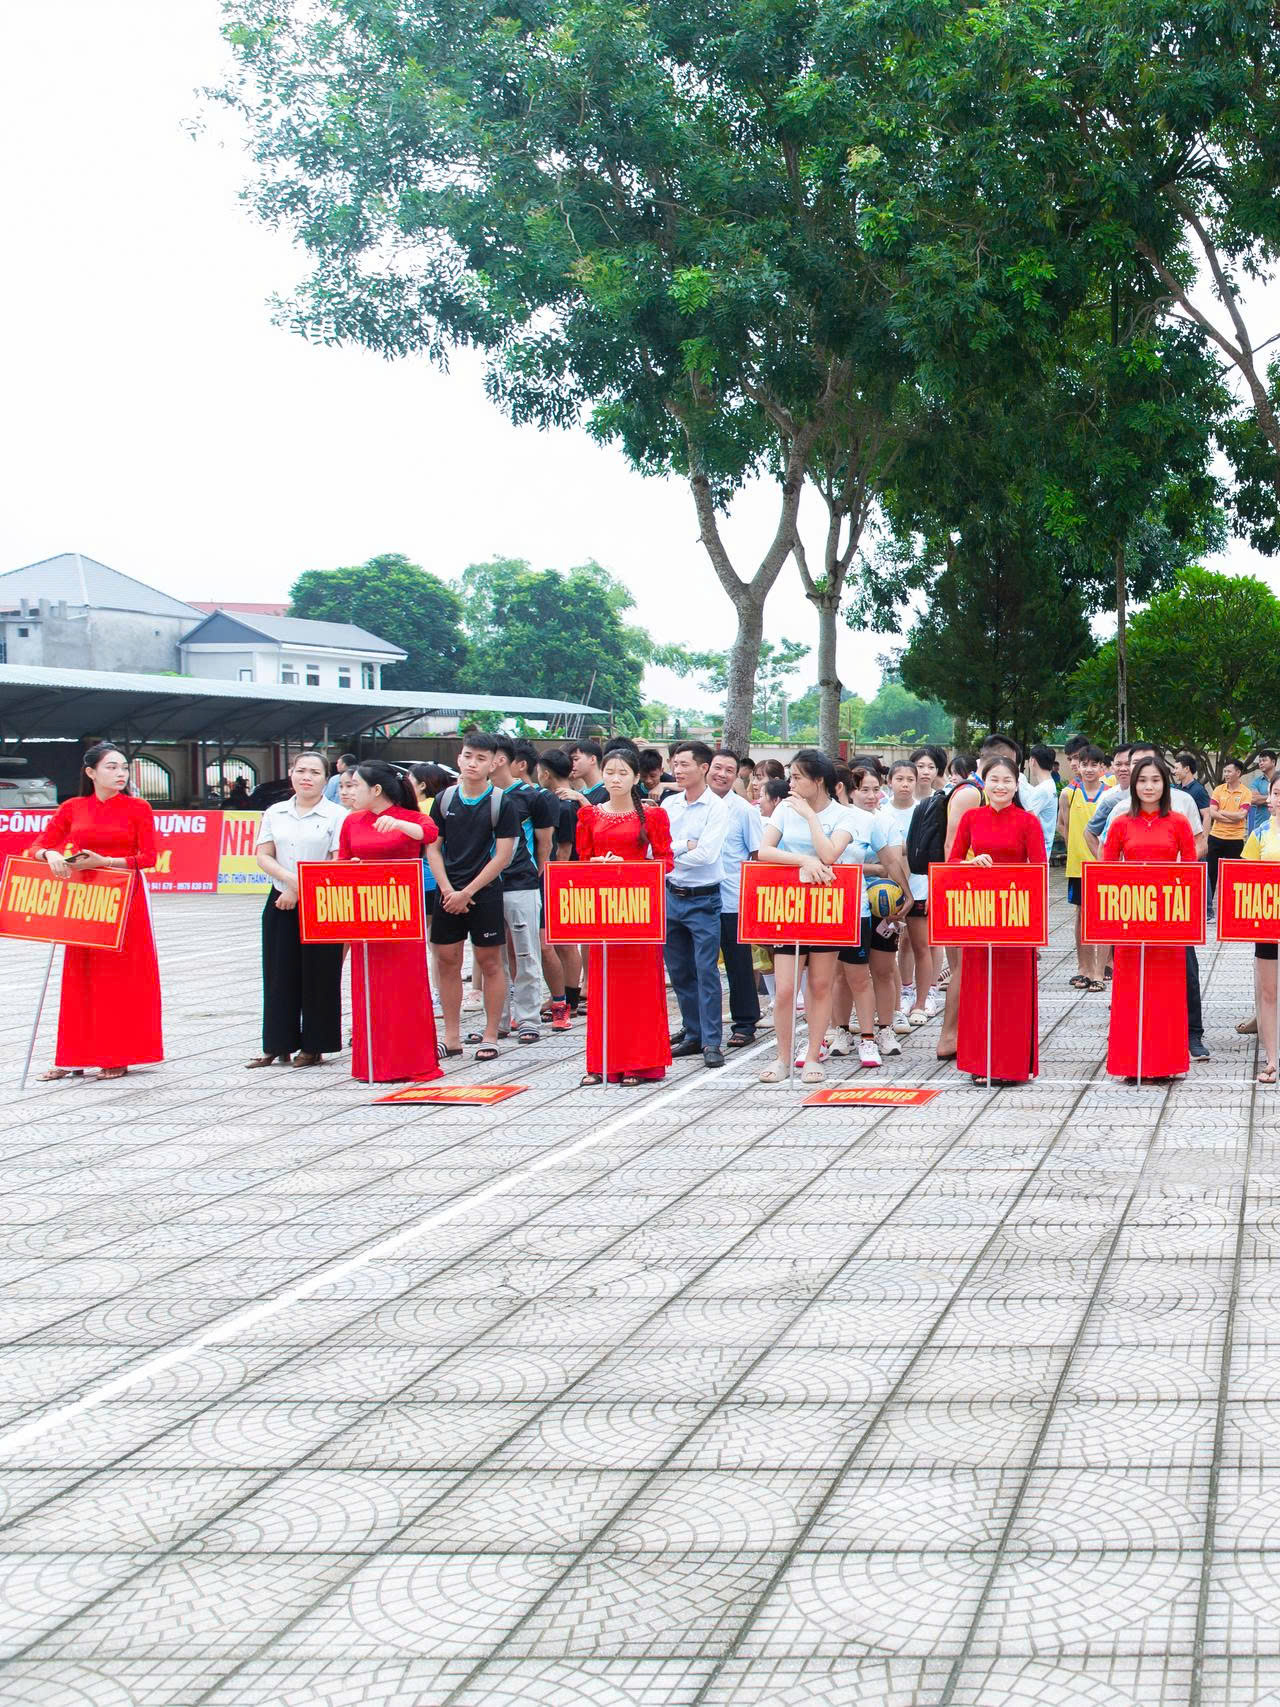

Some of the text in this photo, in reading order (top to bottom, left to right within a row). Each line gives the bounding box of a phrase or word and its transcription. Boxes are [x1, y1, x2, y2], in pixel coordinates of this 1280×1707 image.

[222, 820, 259, 856] NH
[8, 876, 121, 923] THẠCH TRUNG
[315, 877, 411, 930] BÌNH THUẬN
[559, 880, 651, 924] BÌNH THANH
[756, 886, 806, 931] THẠCH
[945, 882, 1030, 927] THÀNH TÂN
[1097, 877, 1191, 930] TRỌNG TÀI
